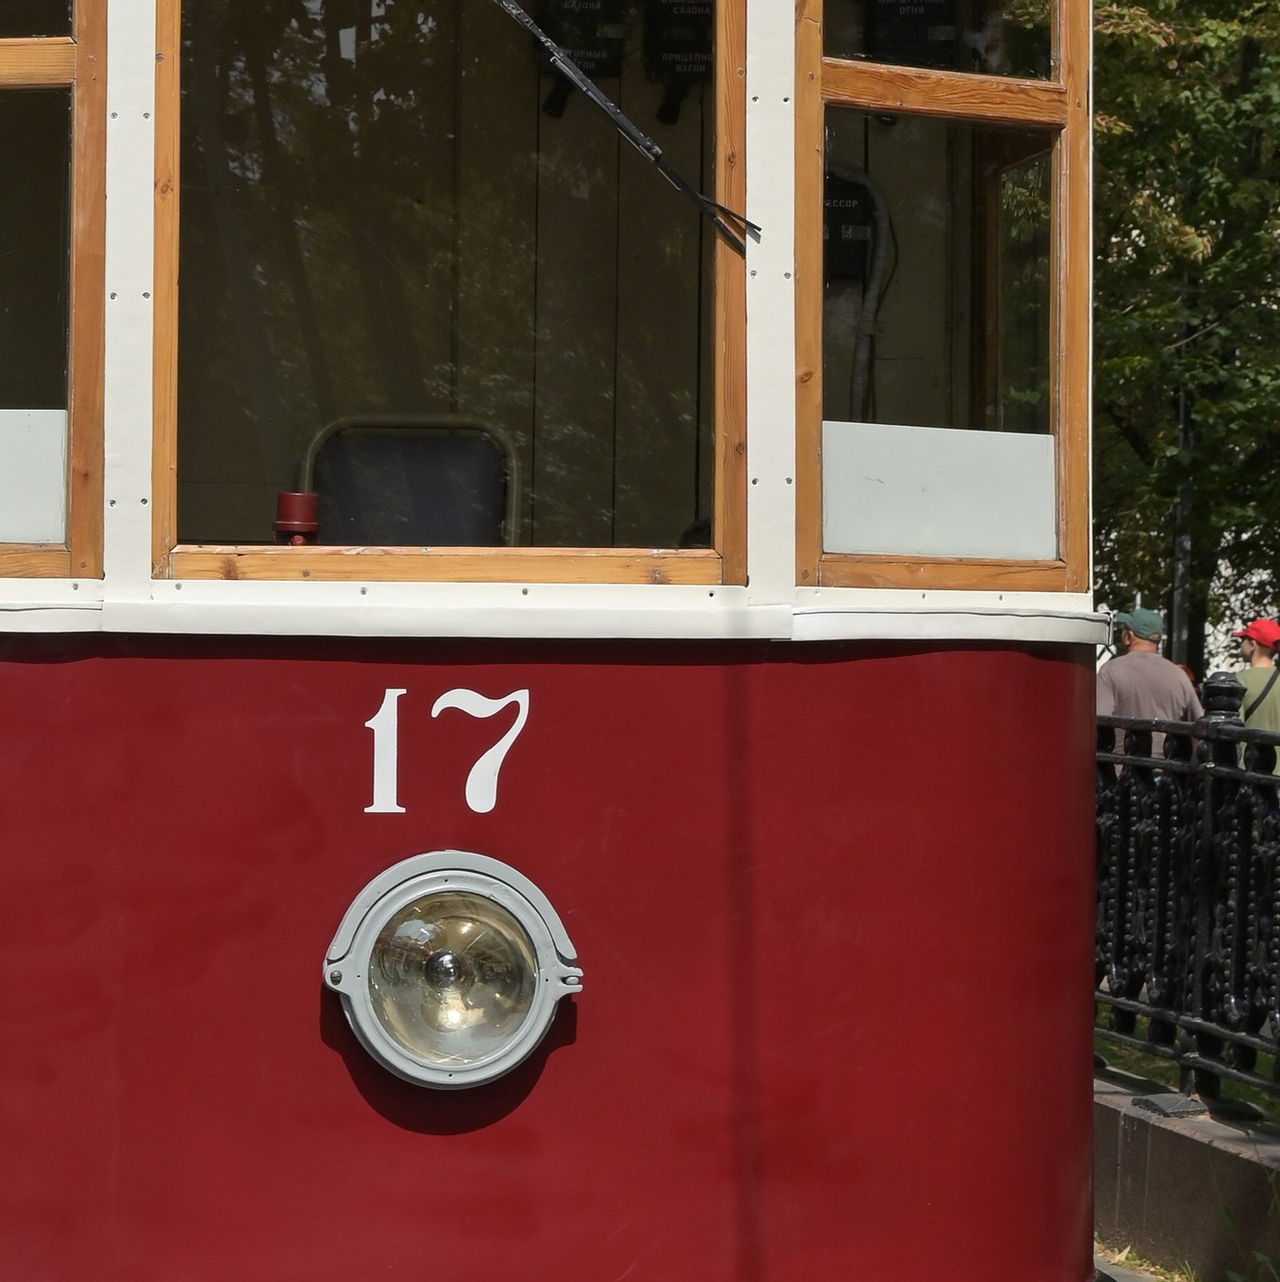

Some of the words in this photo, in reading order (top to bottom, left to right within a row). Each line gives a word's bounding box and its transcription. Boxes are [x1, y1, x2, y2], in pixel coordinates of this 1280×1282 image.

[673, 6, 711, 15] САЛОНА
[899, 6, 925, 15] ОГНИ
[676, 64, 706, 73] ВАГОН
[363, 688, 530, 814] 17
